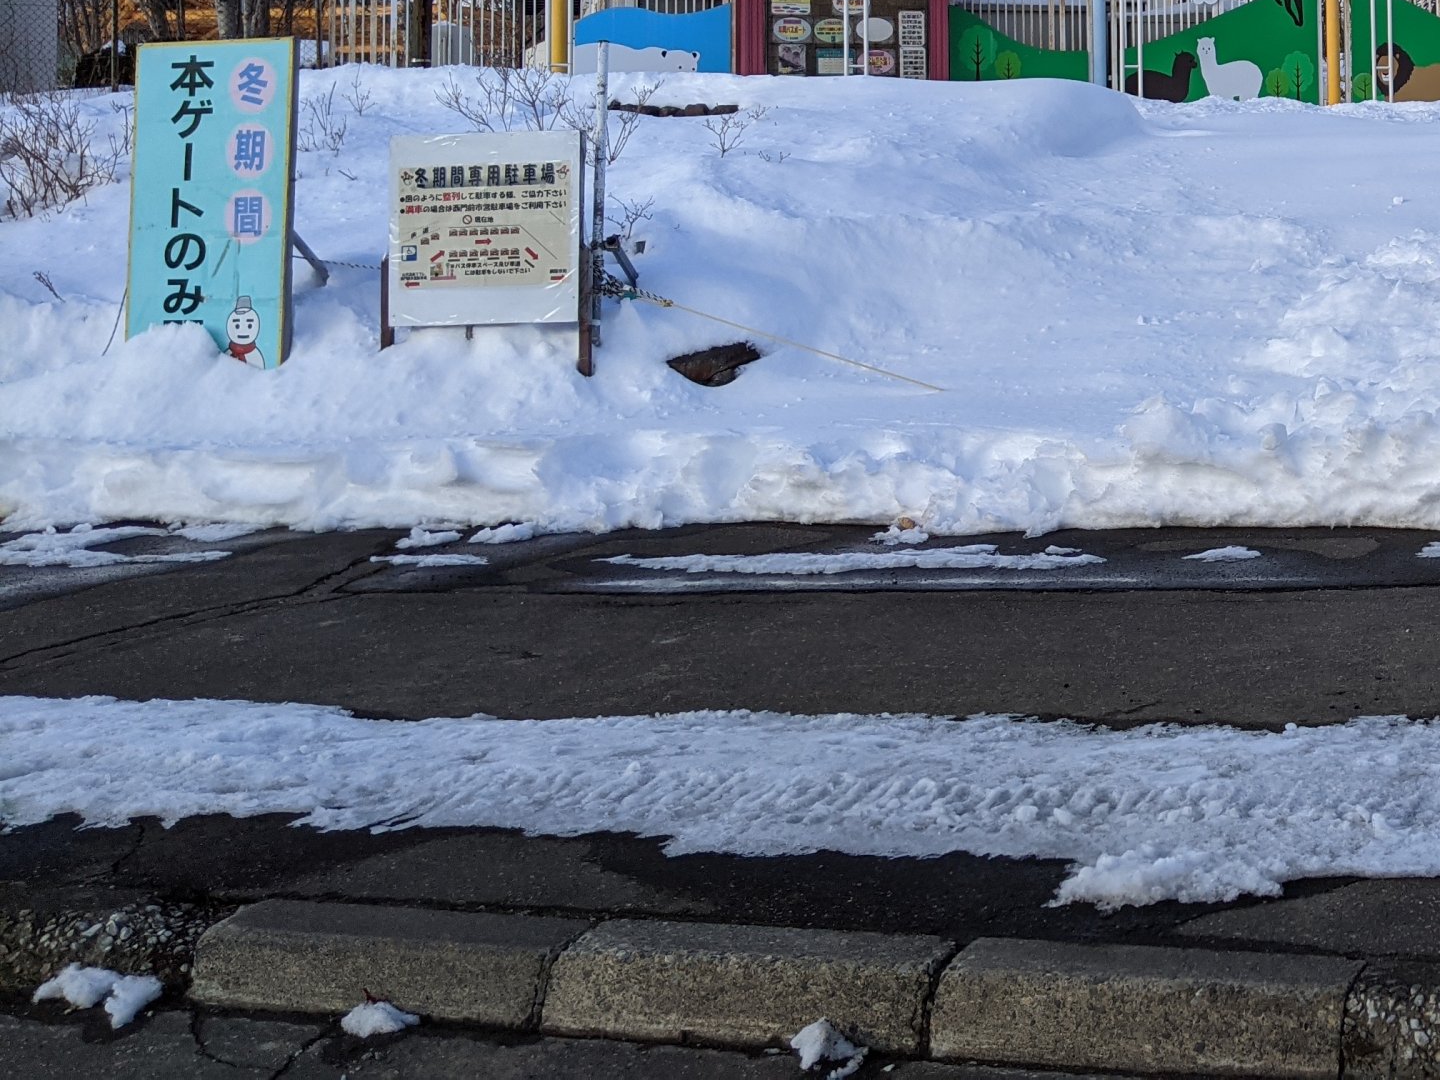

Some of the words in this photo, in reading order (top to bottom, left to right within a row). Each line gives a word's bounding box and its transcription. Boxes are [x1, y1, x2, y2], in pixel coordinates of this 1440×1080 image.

[162, 54, 215, 327] 本ゲートのみ
[233, 62, 269, 238] 冬期間
[414, 162, 556, 188] 冬期間専用駐車場
